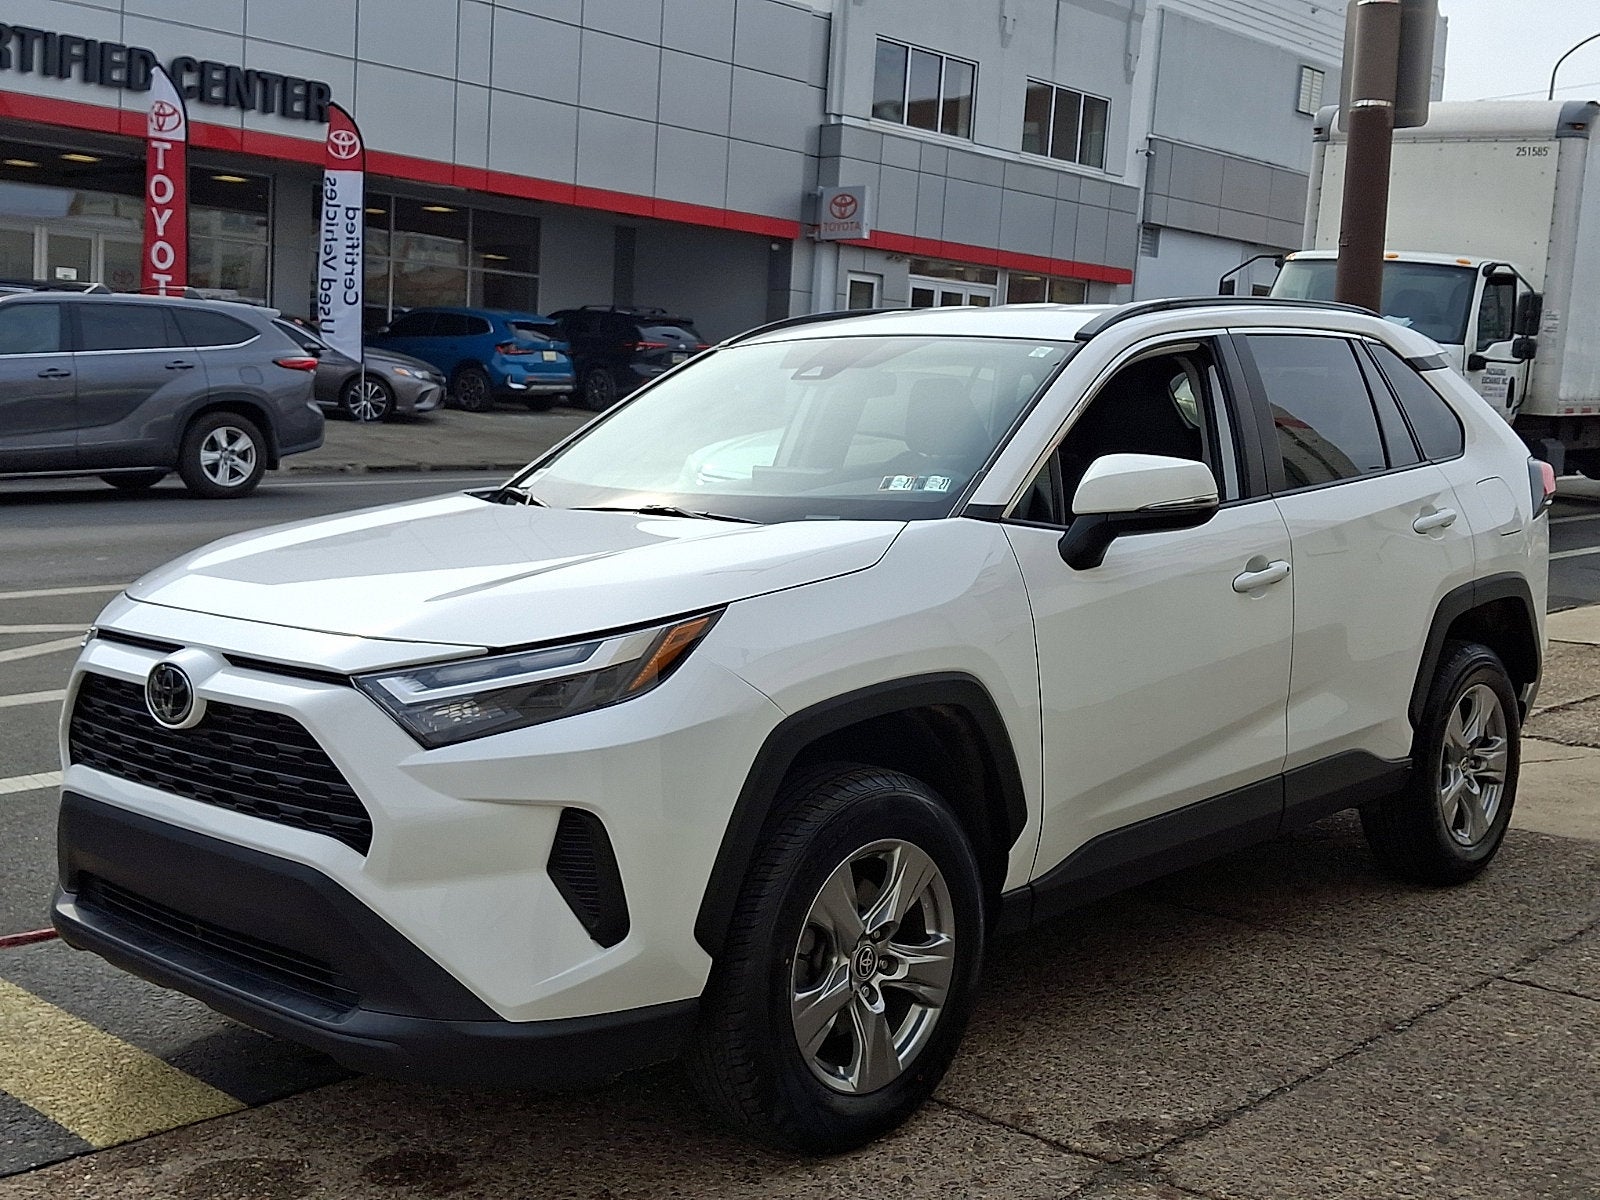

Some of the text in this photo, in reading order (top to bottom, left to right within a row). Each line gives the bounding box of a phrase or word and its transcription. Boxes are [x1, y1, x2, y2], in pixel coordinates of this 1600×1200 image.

[171, 56, 332, 123] CENTER
[1516, 146, 1549, 157] 251585
[823, 221, 861, 232] TOYOTA
